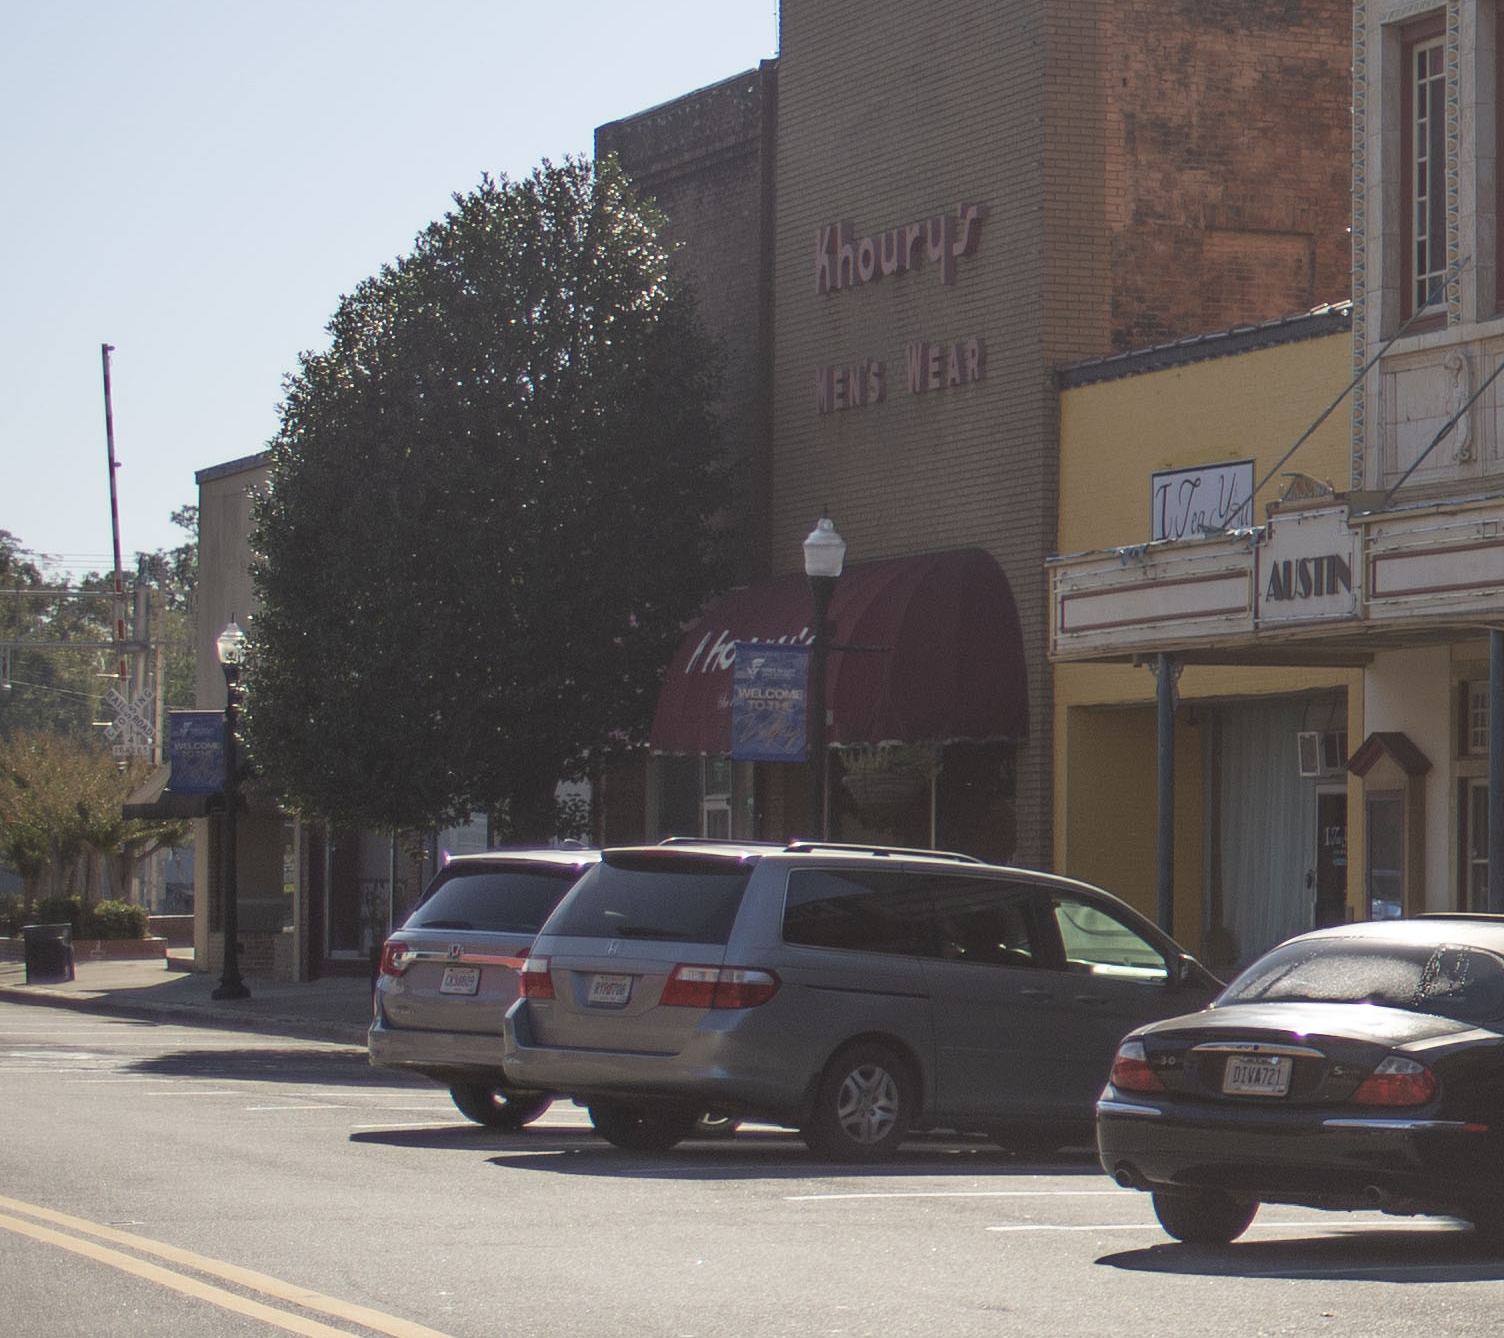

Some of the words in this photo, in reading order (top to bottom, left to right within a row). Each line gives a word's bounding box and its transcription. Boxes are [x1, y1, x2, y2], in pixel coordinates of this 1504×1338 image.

[815, 202, 986, 295] Khoury's
[815, 358, 886, 413] MEN'S
[905, 337, 985, 393] WEAR
[1266, 552, 1352, 602] AUSTIN
[106, 691, 153, 736] RAILROAD
[739, 688, 804, 700] WELCOME
[748, 700, 765, 710] TO
[1233, 1066, 1281, 1085] DIVA721
